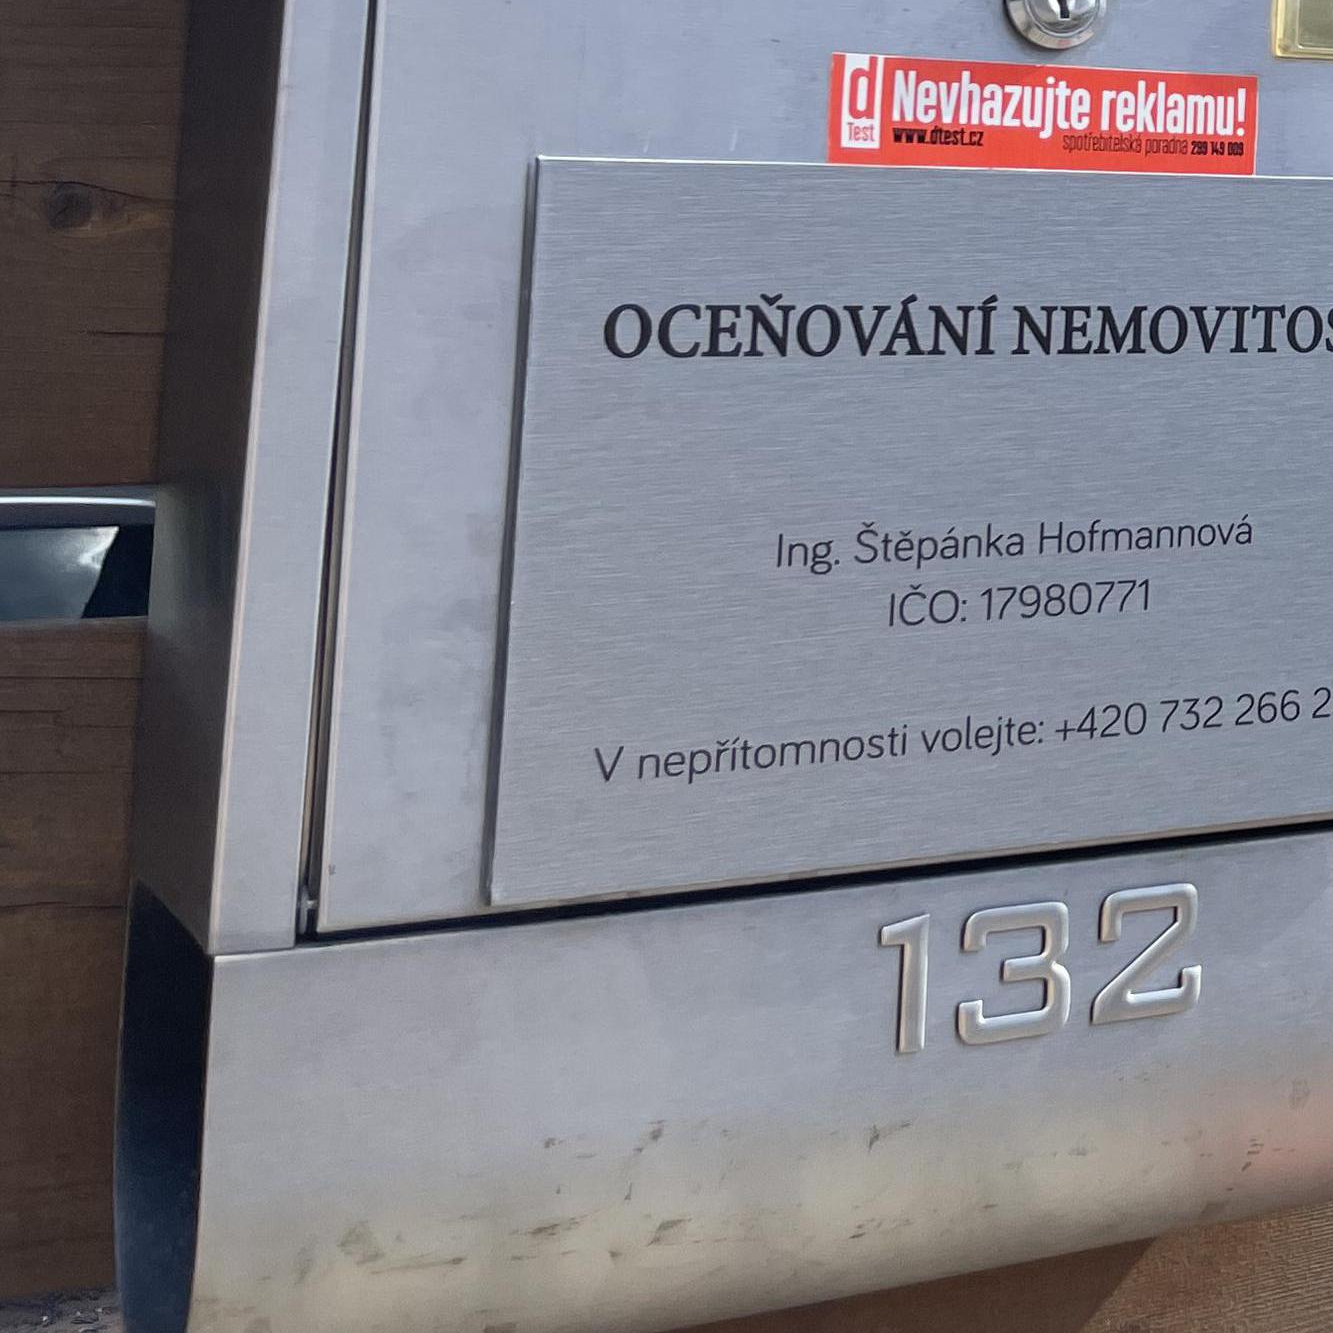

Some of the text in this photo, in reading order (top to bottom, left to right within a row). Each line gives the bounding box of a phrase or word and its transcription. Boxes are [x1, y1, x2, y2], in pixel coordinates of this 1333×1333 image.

[847, 122, 876, 143] Test
[891, 69, 1246, 140] Nevhazujte reklamu!
[892, 125, 985, 147] www.dtest.cz
[1145, 136, 1188, 157] poradna
[603, 294, 997, 359] OCEŇOVÁNÍ
[776, 513, 1254, 575] Ing. Štěpánka Hofmannová
[889, 578, 1151, 627] IČO: 17980771
[594, 746, 625, 782] V
[637, 724, 908, 785] nepřítomnosti
[920, 715, 1044, 757] volejte:
[1055, 702, 1148, 743] +420
[1160, 696, 1224, 733] 732
[1235, 689, 1301, 727] 266
[879, 882, 1202, 1055] 132
